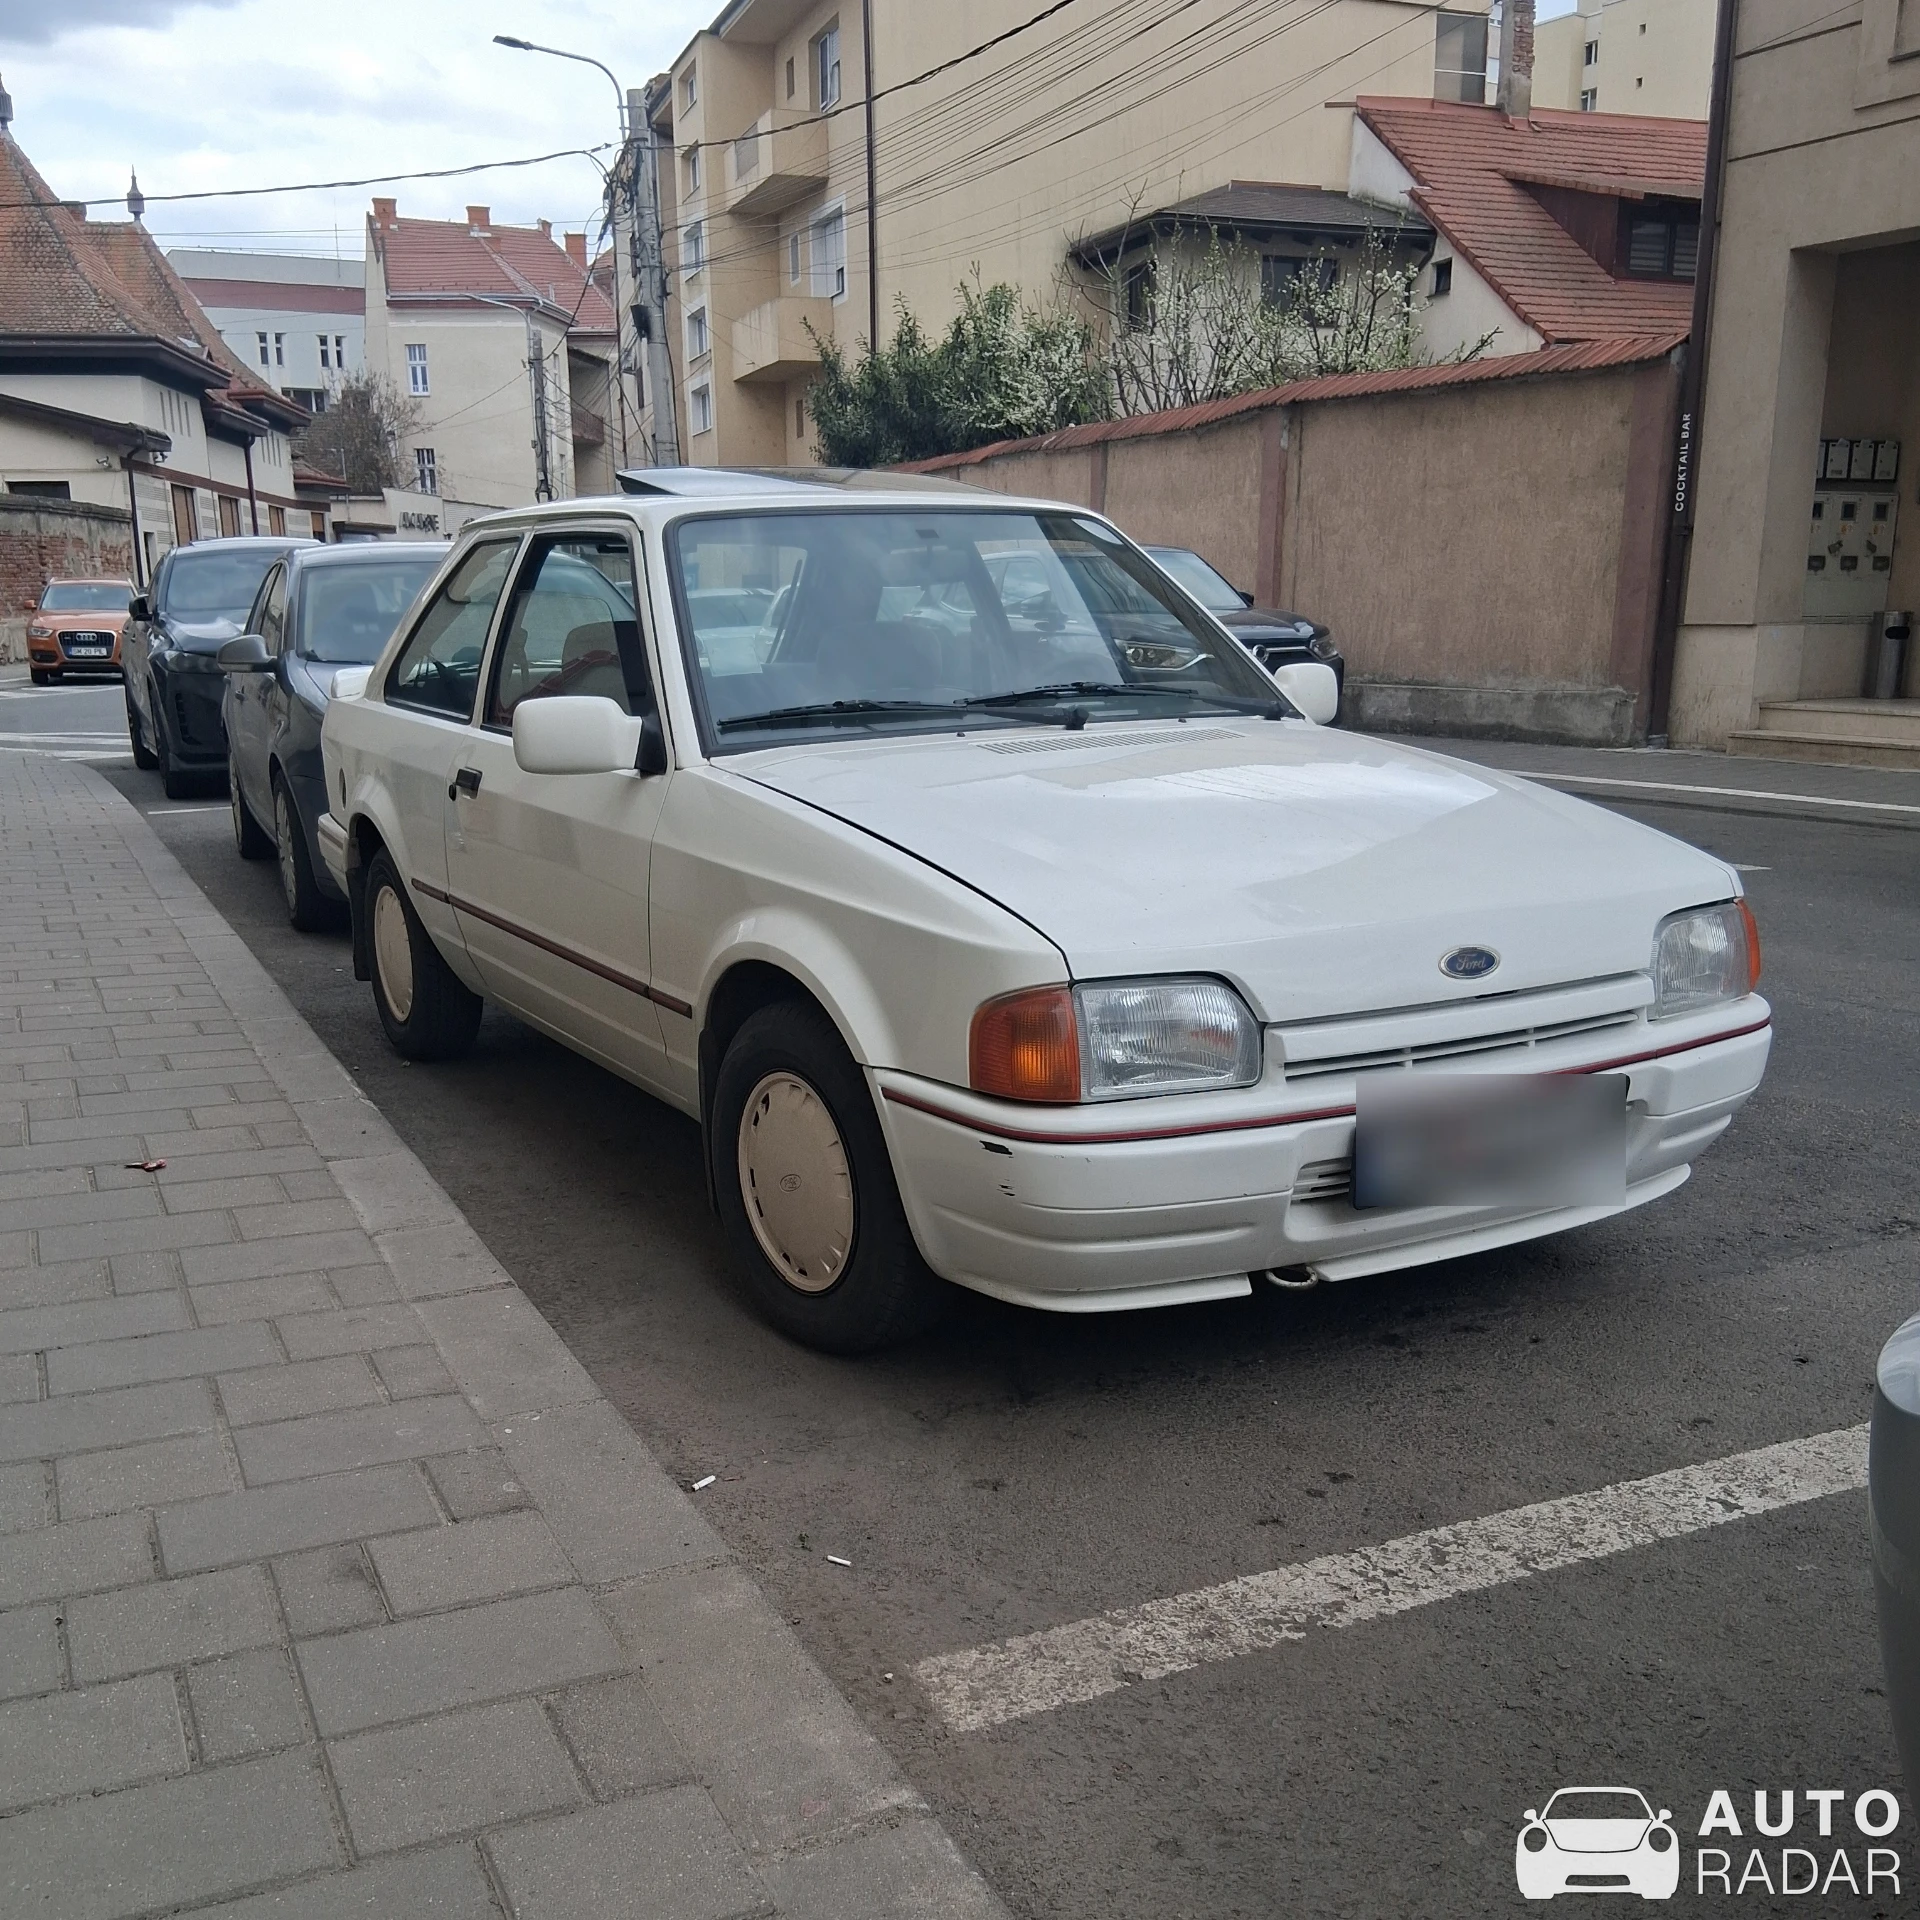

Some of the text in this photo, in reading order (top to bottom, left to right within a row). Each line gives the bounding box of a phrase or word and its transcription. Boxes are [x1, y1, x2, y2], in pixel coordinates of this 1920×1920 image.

[1674, 413, 1691, 512] COCKTAIL BAR
[1456, 953, 1487, 971] Ford
